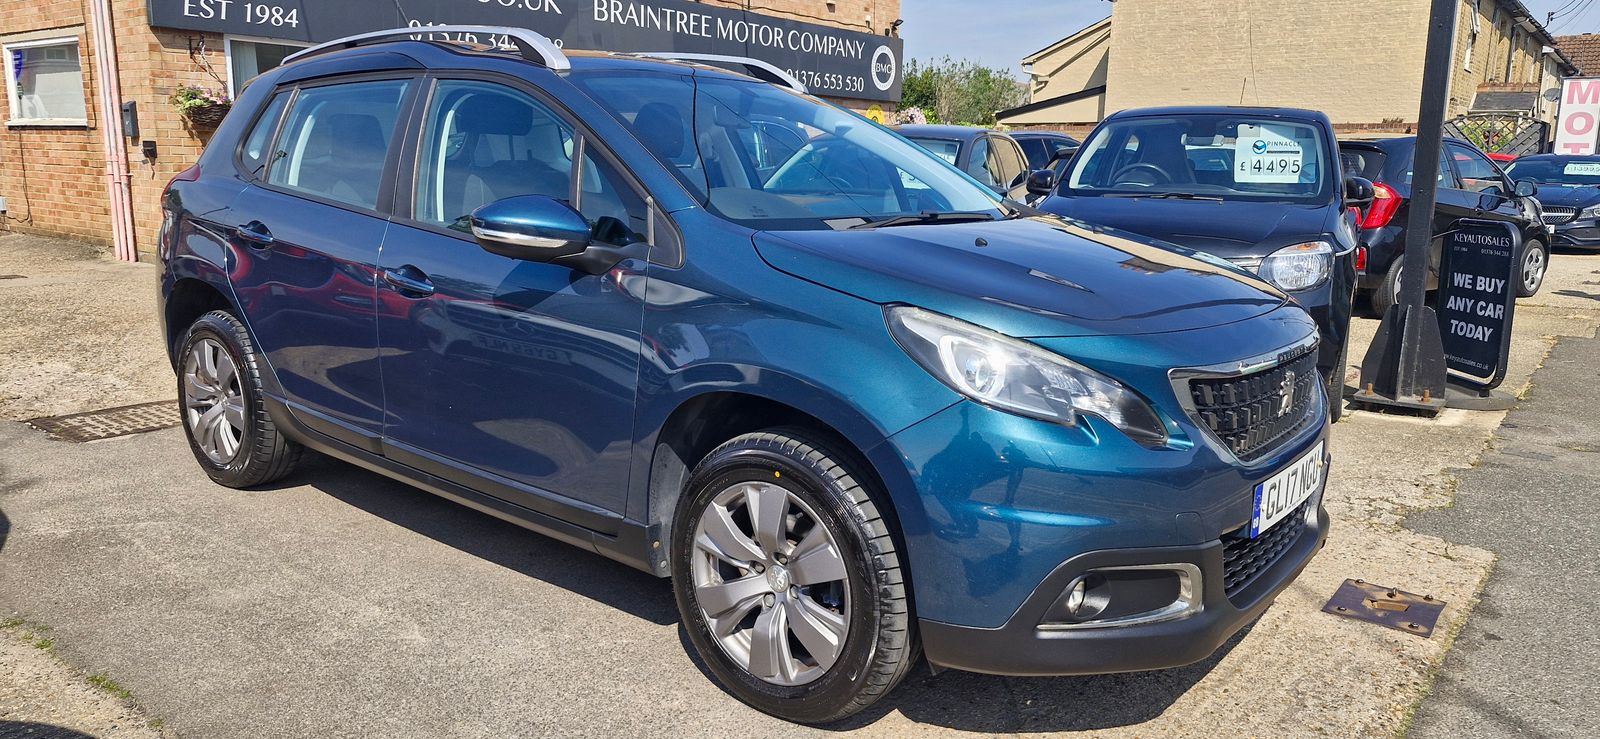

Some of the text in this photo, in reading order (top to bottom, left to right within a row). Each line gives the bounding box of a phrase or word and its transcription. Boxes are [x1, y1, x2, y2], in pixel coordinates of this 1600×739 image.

[183, 0, 299, 28] EST 1984
[593, 0, 865, 60] BRAINTREE MOTOR COMPANY
[876, 63, 892, 74] BMC
[823, 73, 843, 89] 553
[845, 76, 865, 92] 530
[1454, 233, 1510, 248] KEYAUTOSALES
[1454, 272, 1506, 294] WE BUY
[1446, 295, 1505, 320] ANY CAR
[1450, 319, 1494, 342] TODAY
[1265, 450, 1321, 520] GL17 NGU
